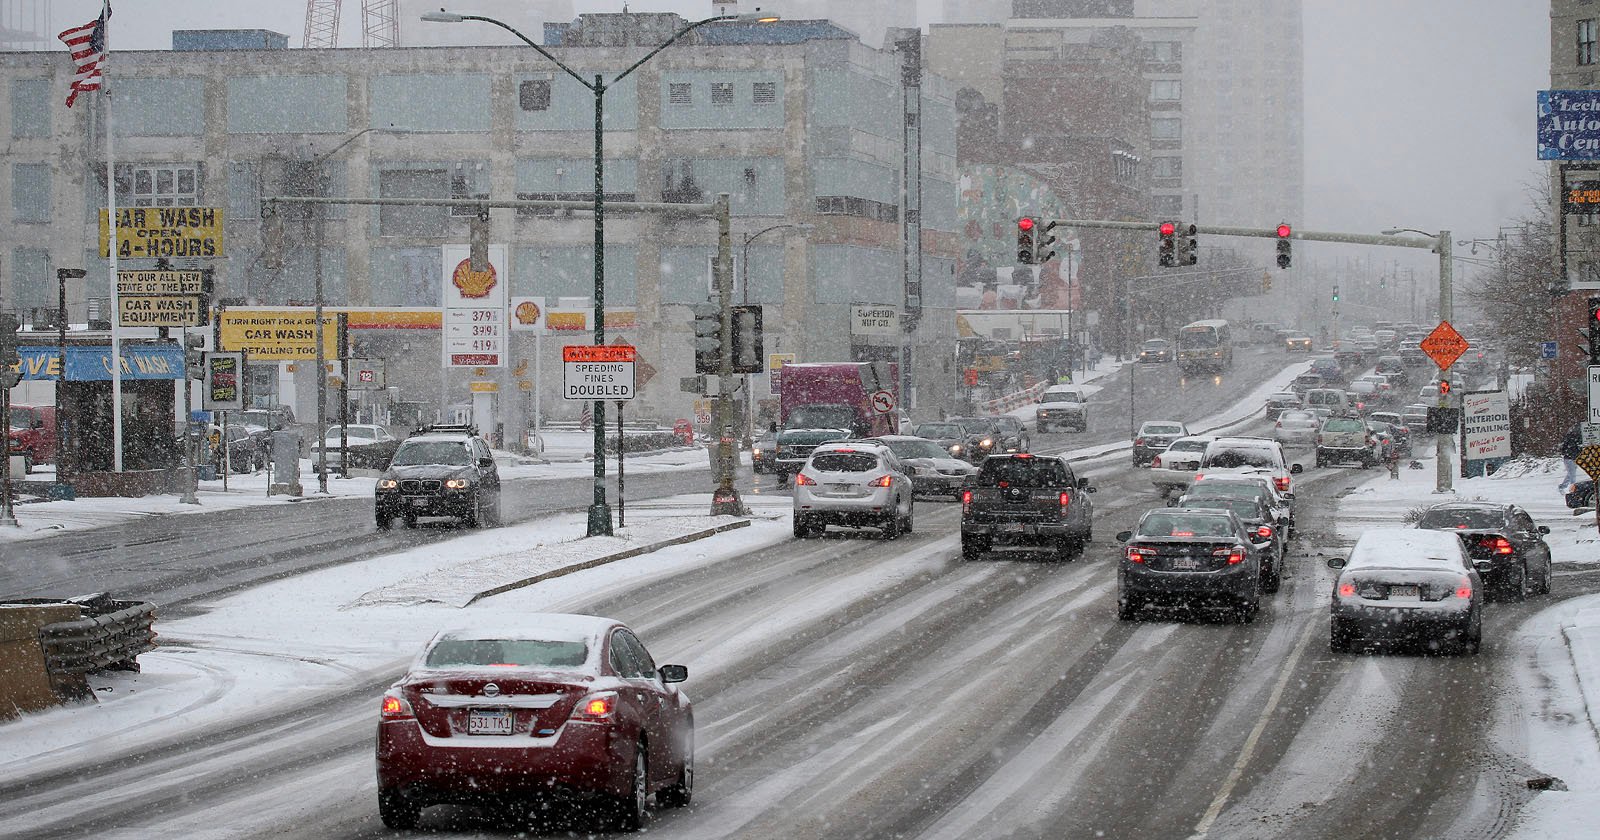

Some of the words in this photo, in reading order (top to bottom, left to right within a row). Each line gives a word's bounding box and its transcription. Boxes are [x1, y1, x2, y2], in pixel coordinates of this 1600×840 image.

[1560, 98, 1600, 111] Lech
[1546, 115, 1600, 132] Auto
[1558, 133, 1600, 150] Cen
[160, 208, 214, 228] WASH
[137, 229, 181, 237] OPEN
[117, 273, 134, 281] TRY
[138, 273, 156, 281] OUR
[160, 273, 176, 281] ALL
[117, 283, 142, 291] STATE
[126, 300, 151, 310] CAR
[157, 300, 192, 310] WASH
[122, 312, 195, 322] EQUIPMENT
[472, 311, 491, 321] 379
[858, 309, 894, 318] SUPERIOR
[862, 319, 876, 327] NUT
[245, 330, 271, 339] CAR
[275, 330, 313, 339] WASH
[472, 326, 492, 336] 399
[472, 340, 491, 350] 419
[135, 355, 172, 374] WASH
[576, 364, 624, 372] SPEEDING
[360, 372, 372, 381] 12
[570, 385, 629, 395] DOUBLED
[1466, 414, 1508, 424] INTERIOR
[1466, 424, 1510, 434] DETAILING
[1479, 445, 1497, 454] Wait
[470, 718, 489, 729] 531
[492, 718, 510, 729] TK1
